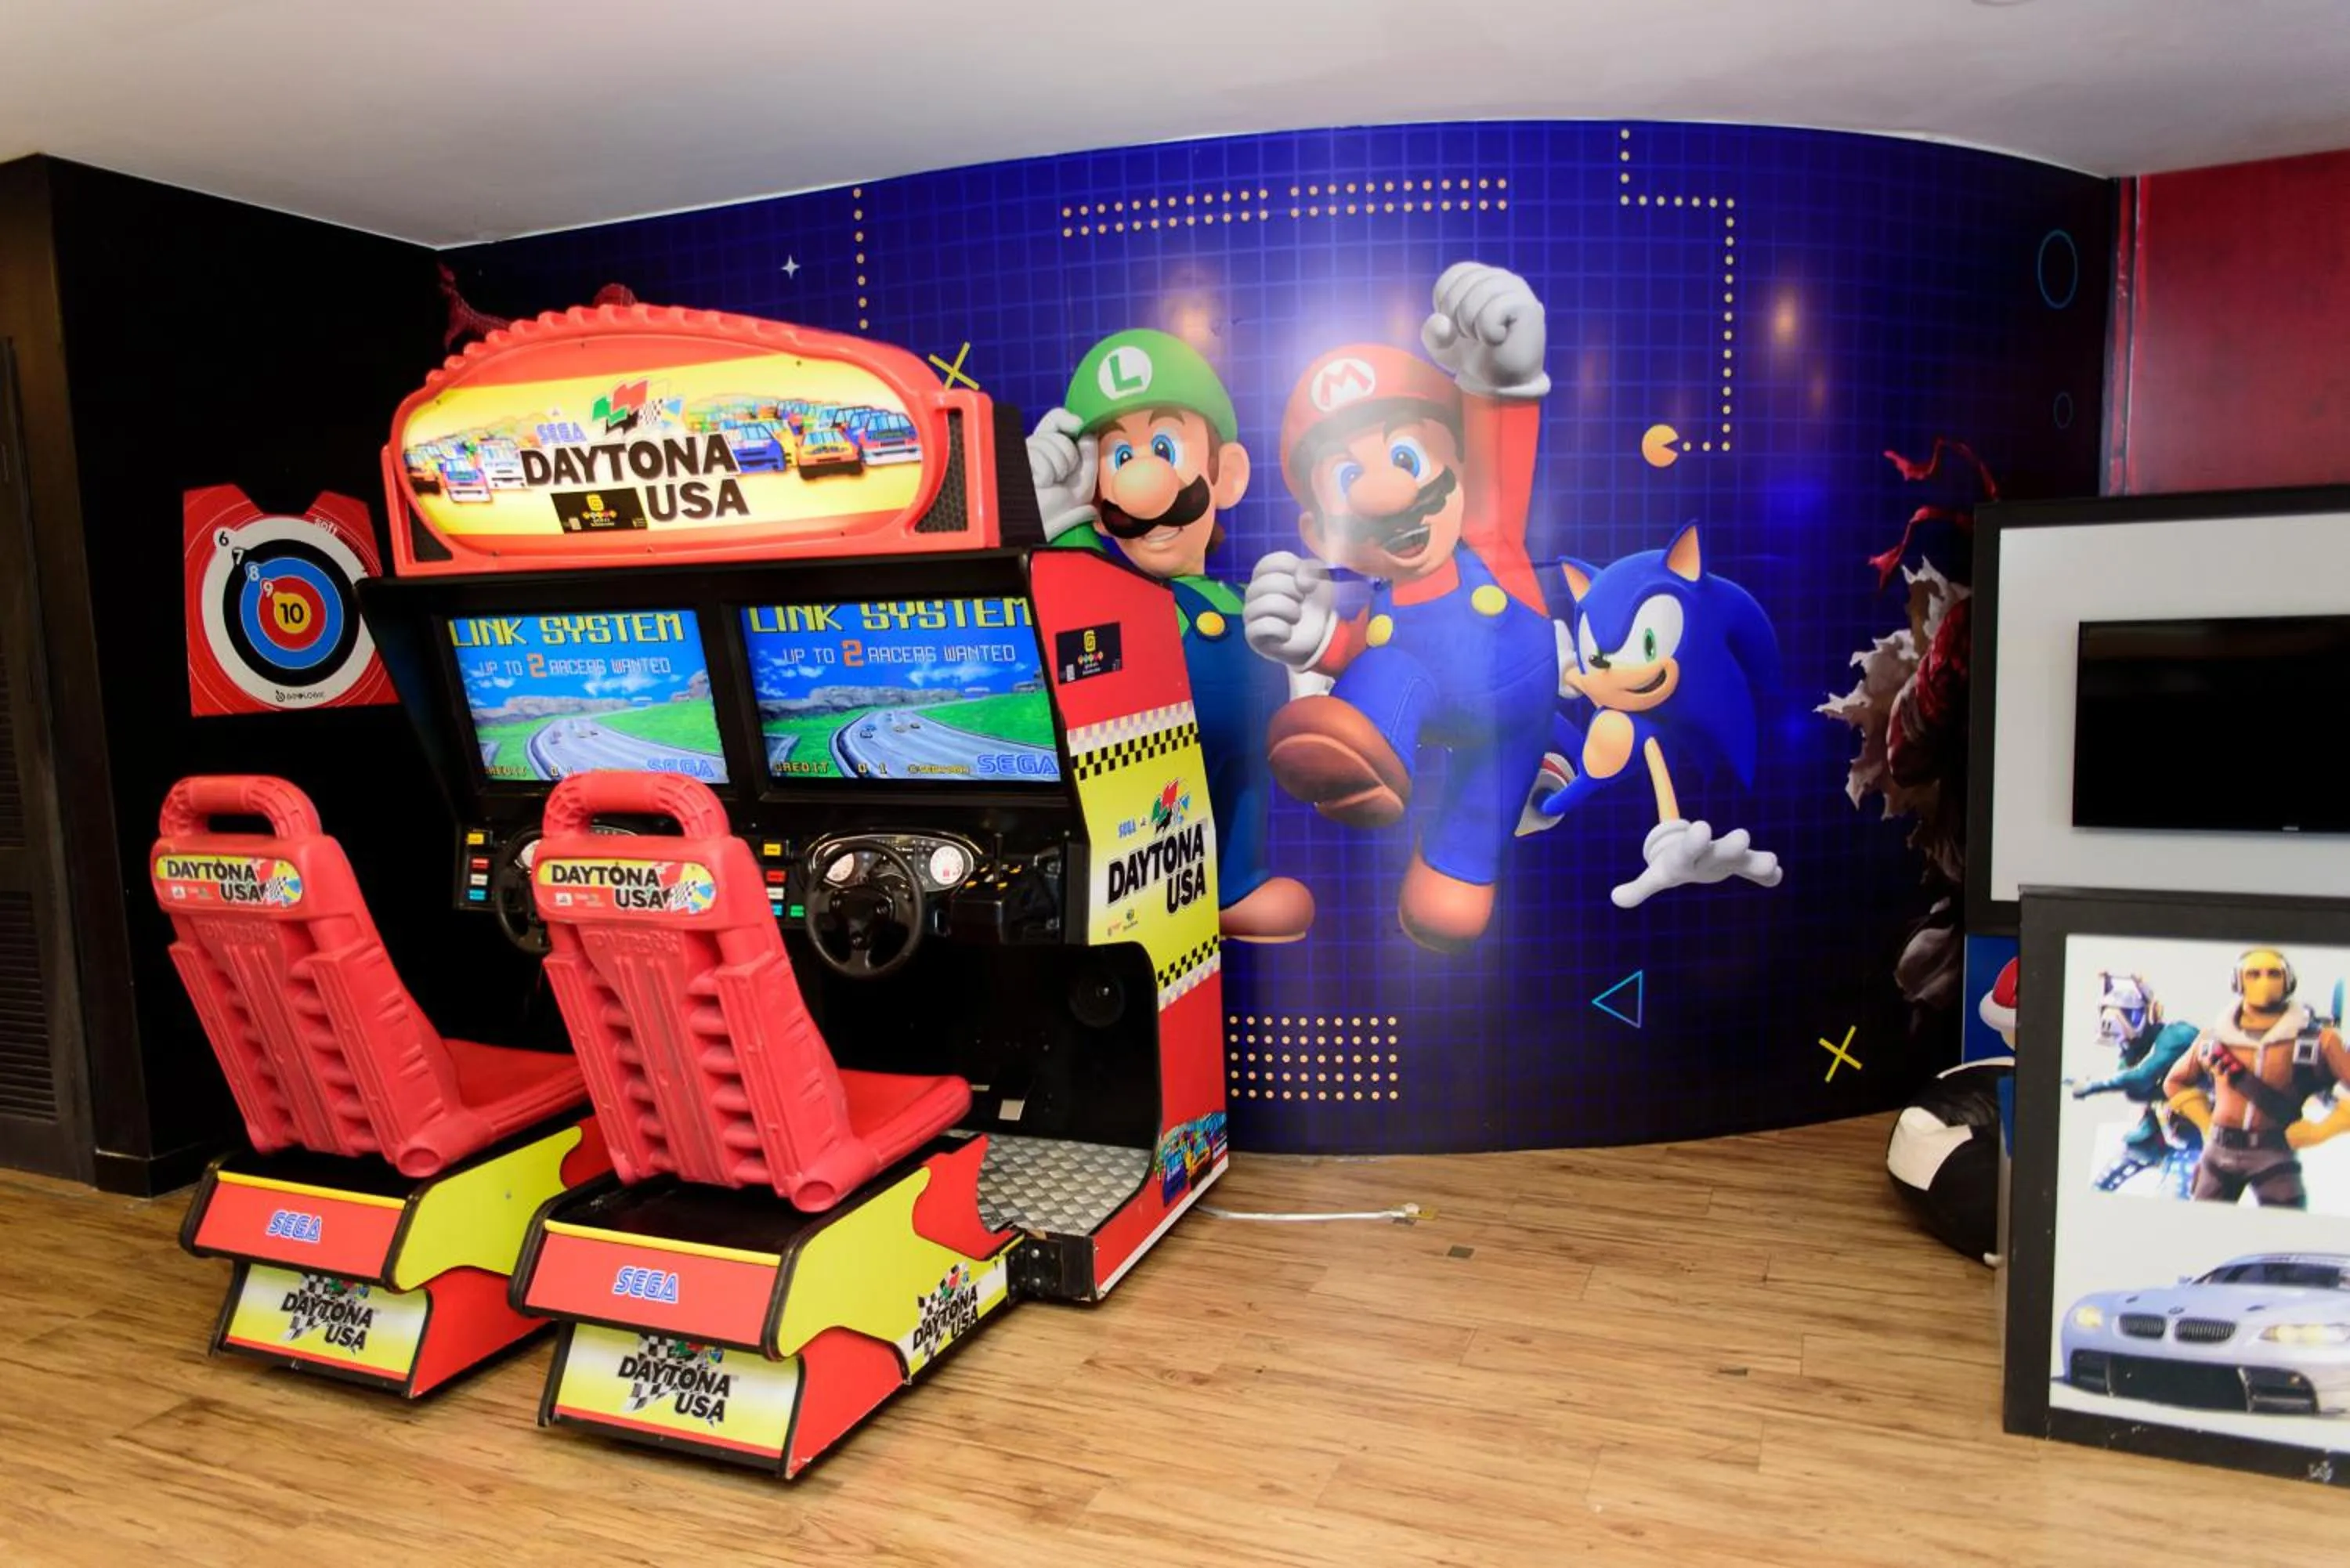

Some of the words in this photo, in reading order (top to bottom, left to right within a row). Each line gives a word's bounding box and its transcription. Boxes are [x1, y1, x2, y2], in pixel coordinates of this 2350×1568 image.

[1108, 354, 1142, 392] L
[1319, 362, 1372, 403] M
[537, 421, 587, 444] SEGA
[520, 433, 739, 486] DAYTONA
[645, 478, 750, 522] USA
[219, 531, 229, 547] 6
[234, 548, 244, 565] 7
[249, 566, 258, 580] 8
[263, 580, 273, 597] 9
[280, 602, 304, 624] 10
[749, 604, 844, 633] LINK
[859, 598, 1032, 630] SYSTEM
[447, 617, 528, 648] LINK
[539, 612, 685, 644] SYSTEM
[479, 660, 497, 677] UP
[504, 660, 522, 677] TO
[526, 652, 547, 678] 2
[549, 657, 606, 676] RACERS
[610, 656, 671, 674] WANTED
[784, 649, 805, 665] UP
[812, 649, 834, 664] TO
[841, 640, 864, 667] 2
[868, 645, 937, 663] RACERS
[944, 645, 1017, 663] WANTED
[976, 753, 1059, 775] SEGA
[166, 860, 258, 882] DAYTONA
[551, 864, 660, 887] DAYTONA
[1108, 823, 1205, 905] DAYTONA
[220, 883, 262, 902] USA
[614, 888, 665, 909] USA
[1166, 862, 1206, 914] USA
[268, 1211, 322, 1242] SEGA
[614, 1266, 679, 1302] SEGA
[280, 1292, 374, 1329] DAYTONA
[913, 1284, 978, 1351] DAYTONA
[950, 1305, 979, 1340] USA
[324, 1324, 367, 1350] USA
[617, 1356, 731, 1399] DAYTONA
[674, 1393, 725, 1423] USA
